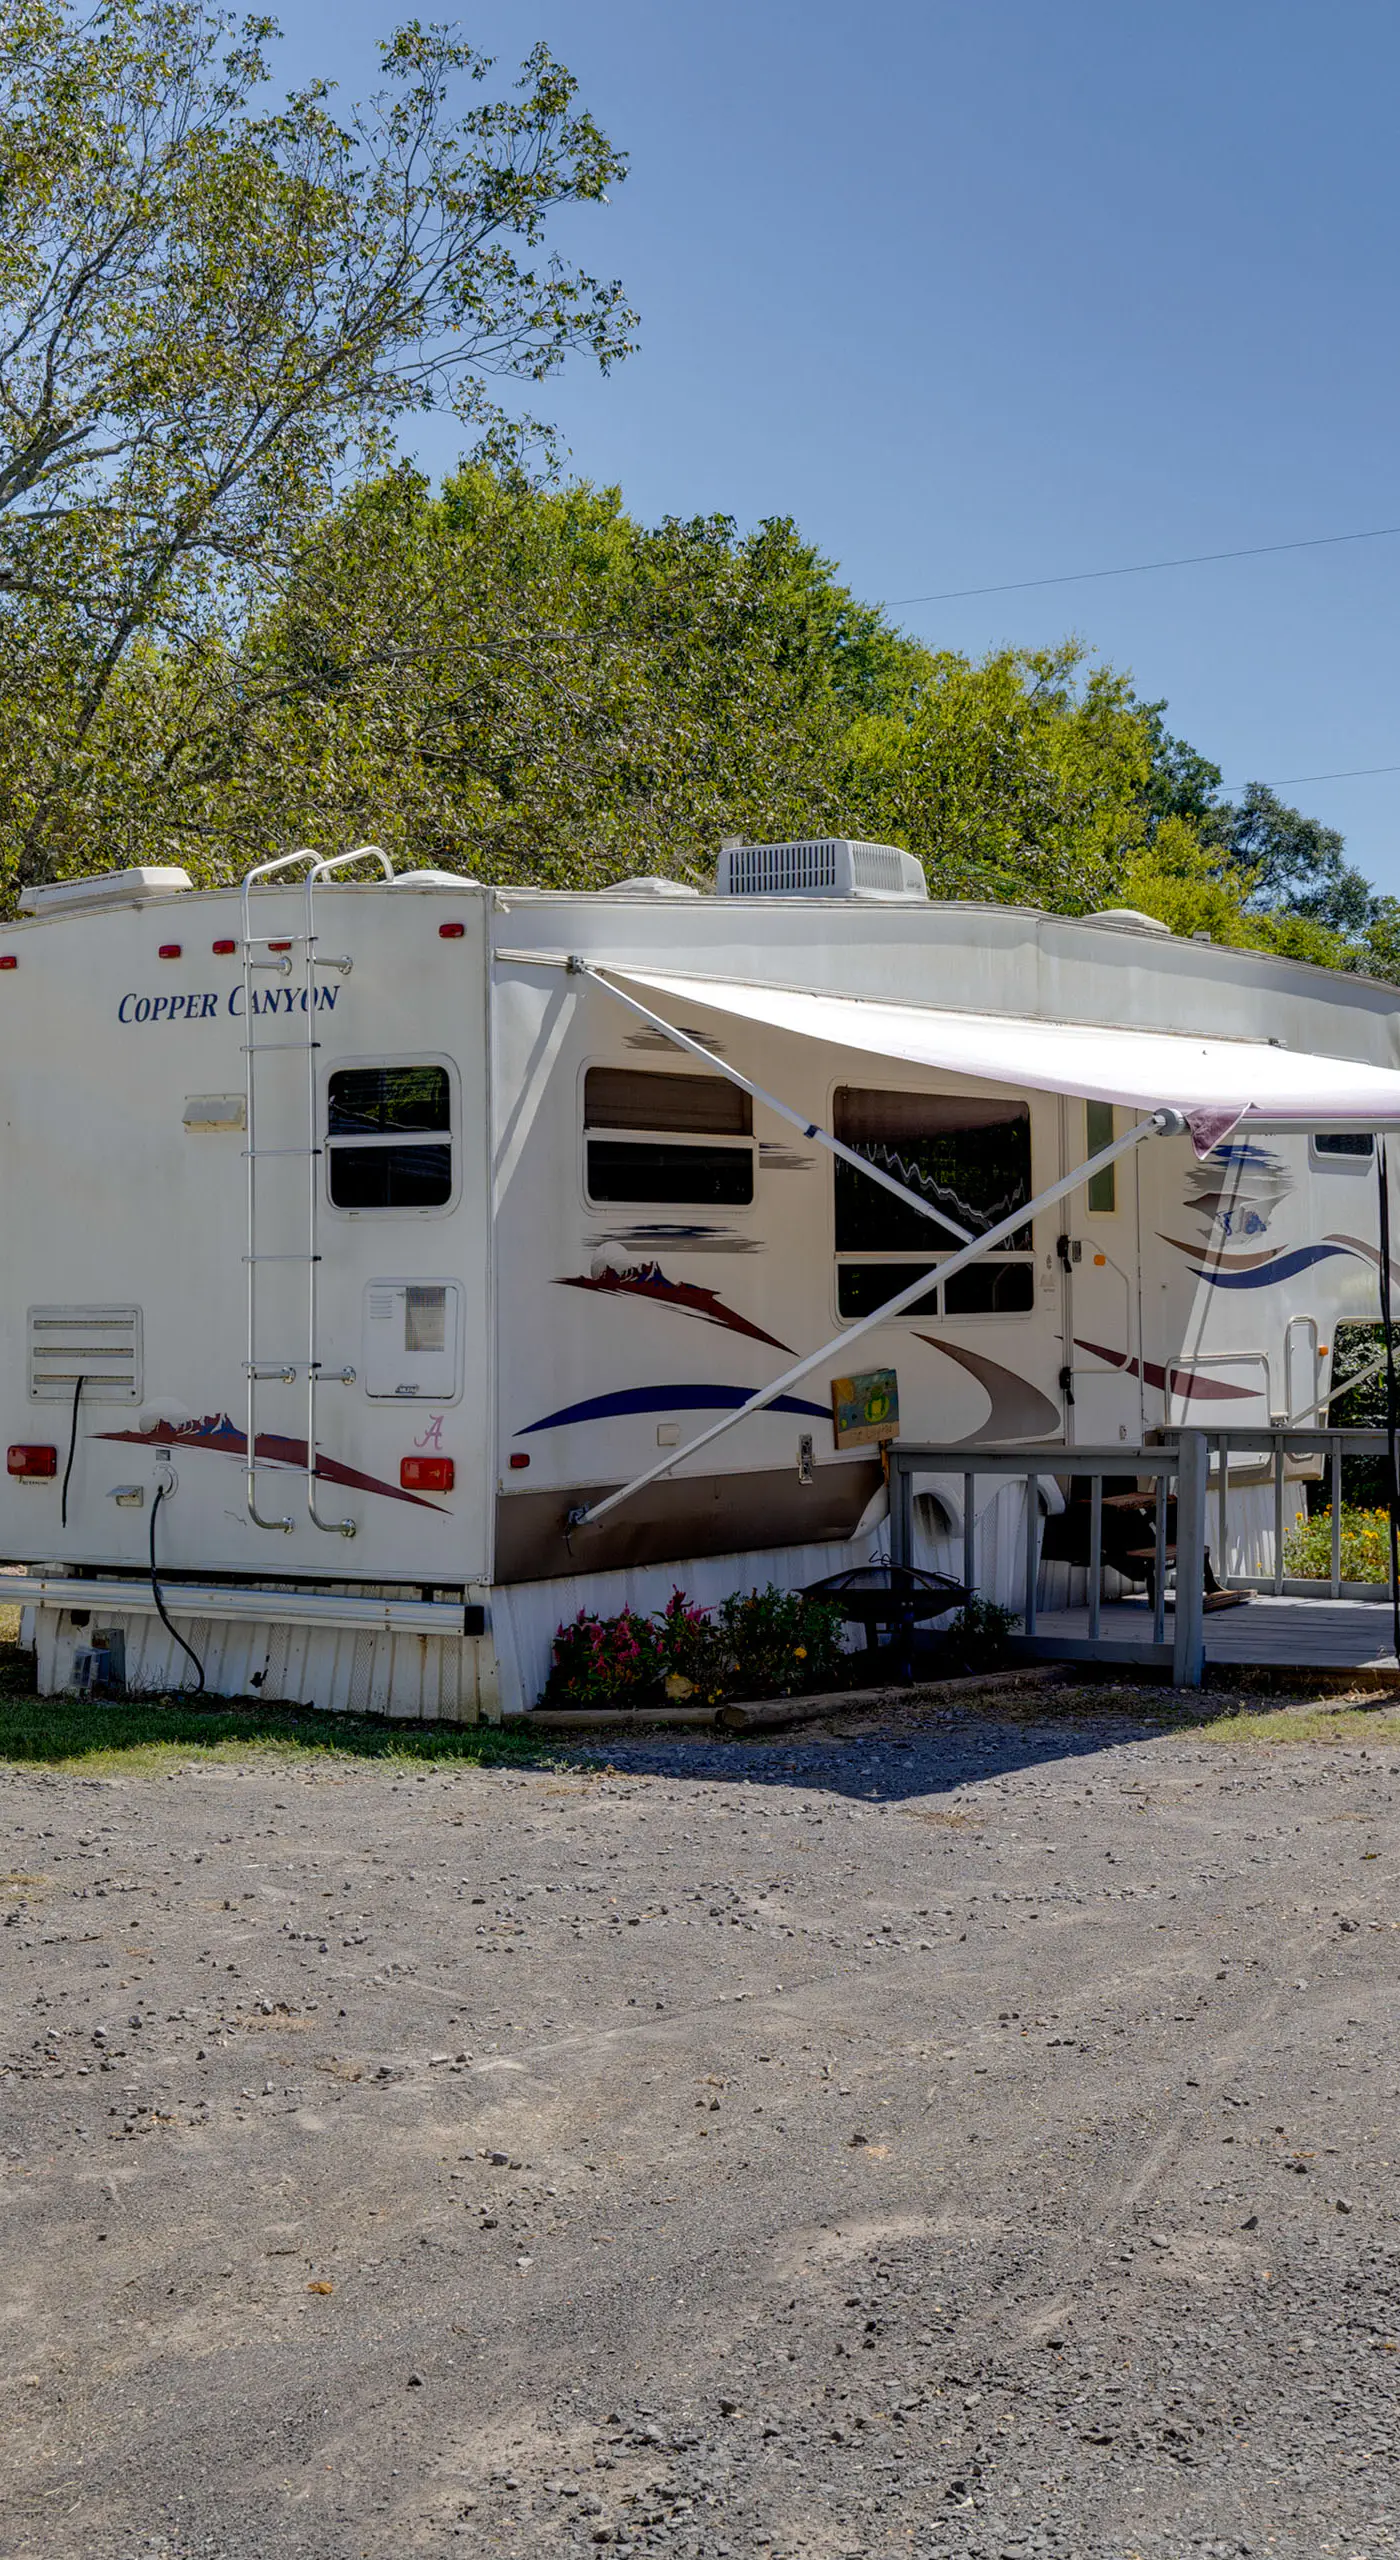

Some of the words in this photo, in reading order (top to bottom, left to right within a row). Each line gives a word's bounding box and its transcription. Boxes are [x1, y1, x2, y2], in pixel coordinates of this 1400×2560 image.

[118, 993, 218, 1024] COPPER
[228, 985, 341, 1016] CANYON
[413, 1413, 445, 1452] A
